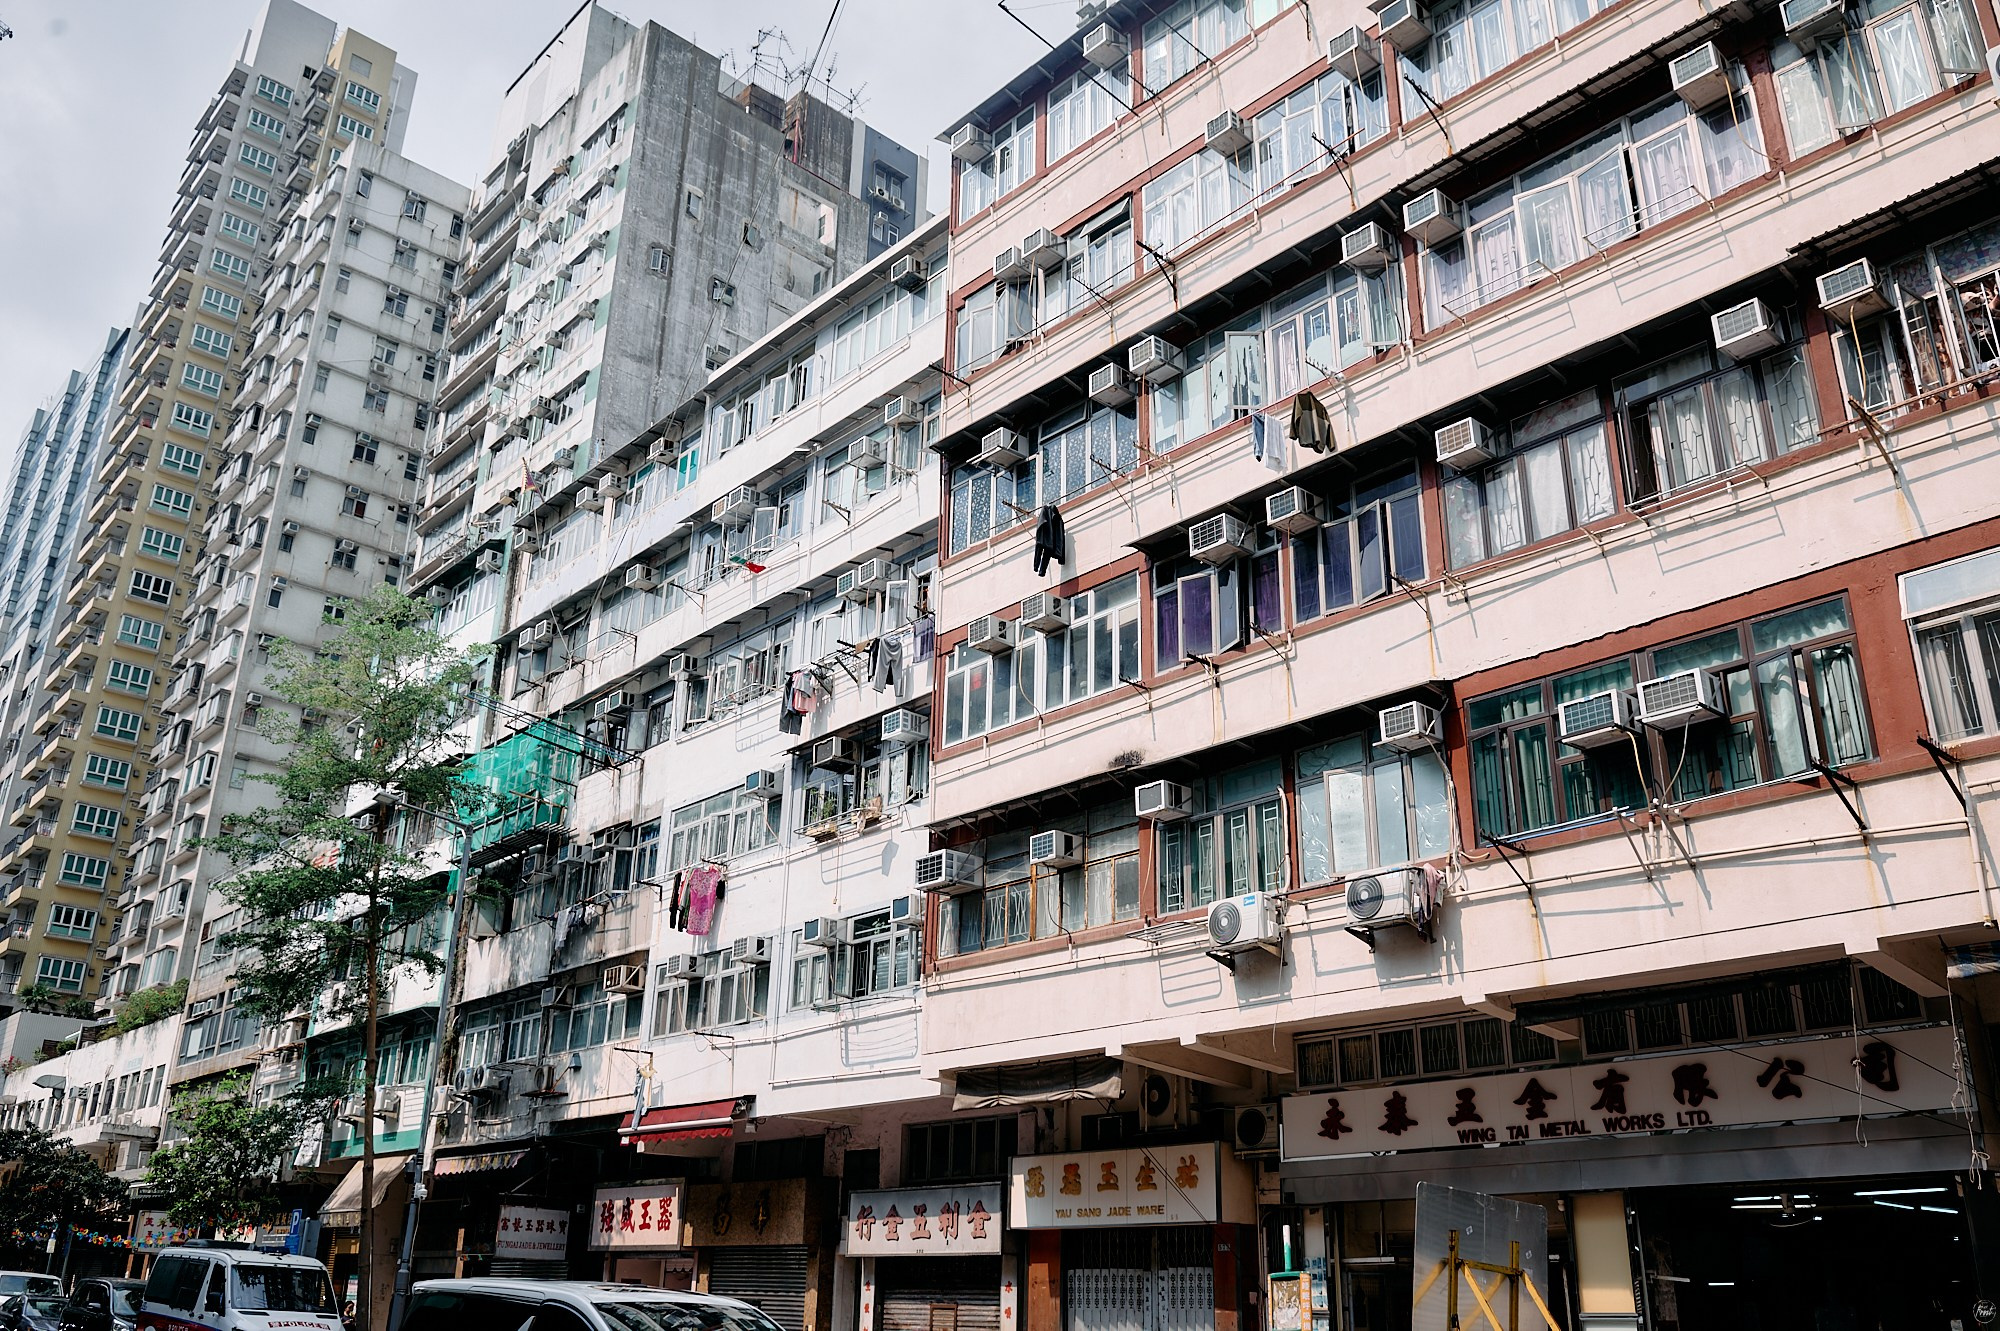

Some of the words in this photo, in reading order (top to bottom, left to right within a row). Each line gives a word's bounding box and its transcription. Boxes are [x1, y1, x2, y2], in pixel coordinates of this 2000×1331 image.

[1317, 1042, 1899, 1140] 永泰五金有限公司
[1457, 1127, 1496, 1143] WING
[1506, 1125, 1530, 1140] TAI
[1539, 1119, 1591, 1138] METAL
[1602, 1113, 1665, 1133] WORKS
[1676, 1110, 1713, 1127] LTD.
[291, 1211, 300, 1234] P
[1055, 1208, 1071, 1219] YAU
[1076, 1207, 1101, 1218] SANG
[1107, 1206, 1132, 1217] JADE
[1136, 1204, 1165, 1216] WARE
